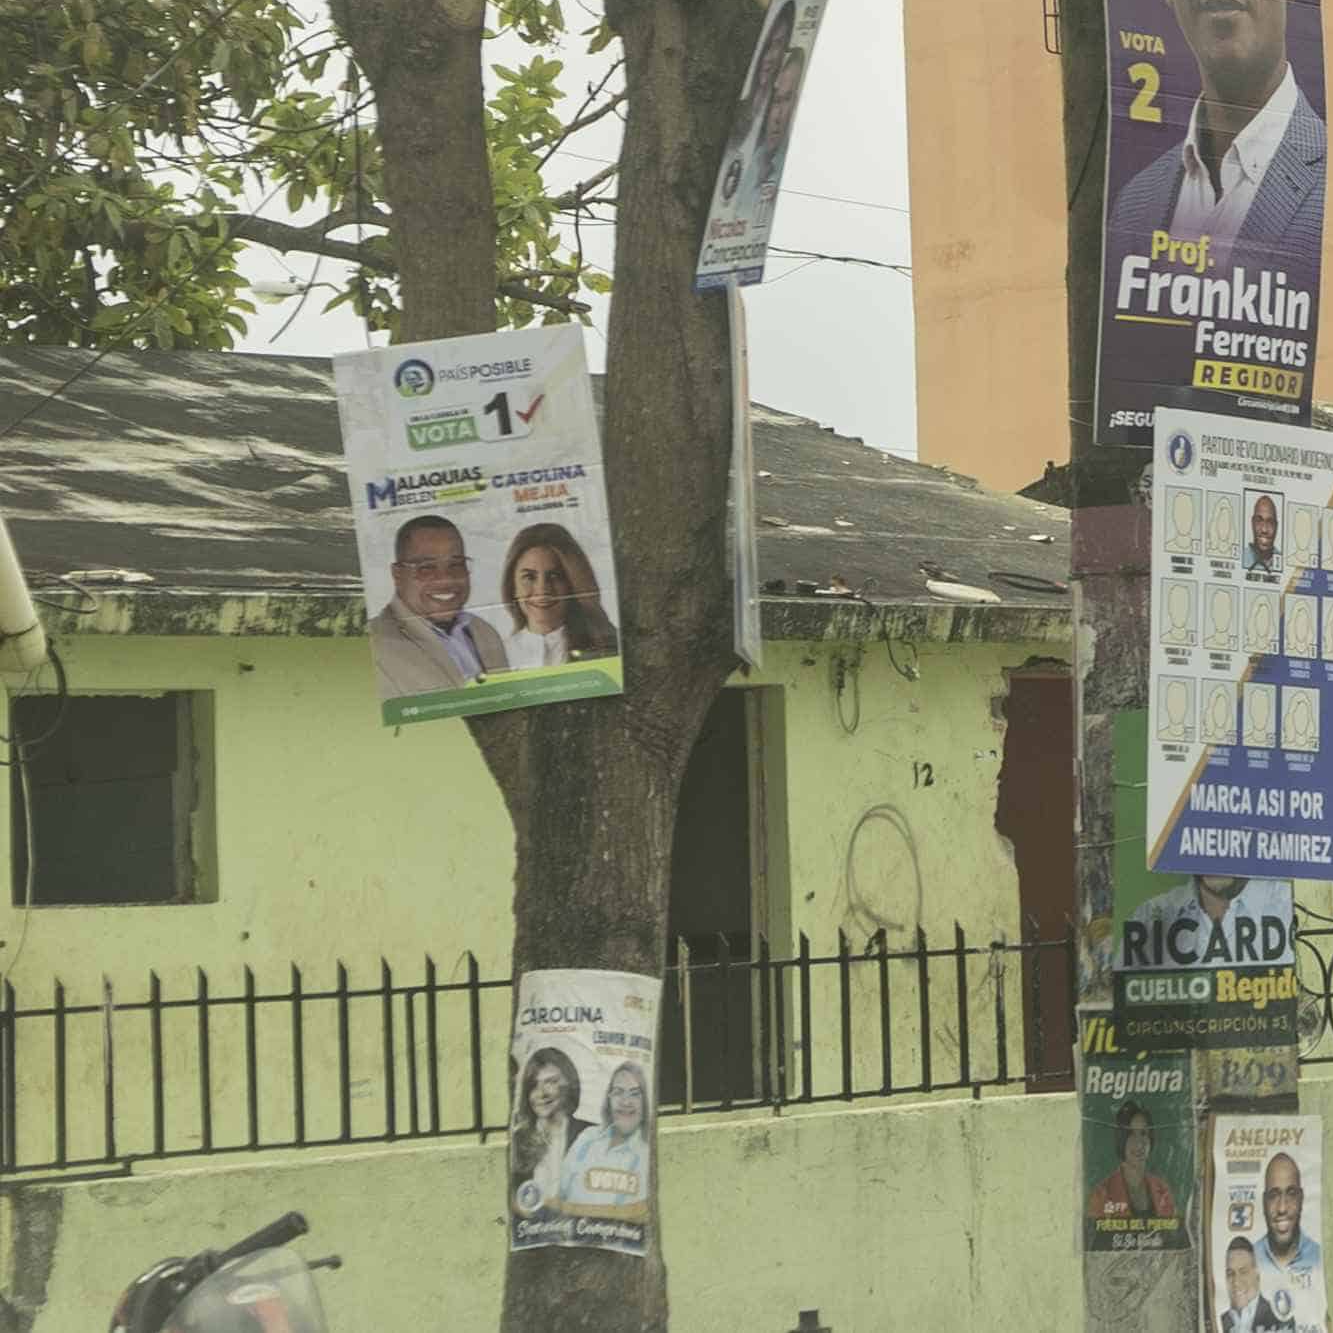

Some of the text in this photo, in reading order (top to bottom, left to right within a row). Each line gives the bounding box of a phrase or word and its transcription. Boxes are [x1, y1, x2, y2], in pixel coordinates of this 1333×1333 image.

[1120, 30, 1165, 55] VOTA
[1128, 63, 1162, 123] 2
[1151, 230, 1215, 273] Prof.
[1117, 255, 1310, 331] Franklin
[1195, 321, 1308, 367] Ferreras
[1200, 364, 1299, 396] REGIDOR
[410, 423, 473, 445] VOTA
[484, 392, 512, 435] 1
[366, 466, 482, 509] MALAQUIAS
[492, 464, 586, 488] CAROLINA
[913, 762, 934, 788] 12
[1191, 783, 1323, 820] MARCA ASI POR
[1179, 827, 1332, 863] ANEURY RAMIREZ
[1123, 916, 1296, 966] RICARD
[1126, 968, 1297, 1009] CUELLO Regid
[1085, 1065, 1184, 1100] Regidora
[1226, 1128, 1304, 1146] ANEURY
